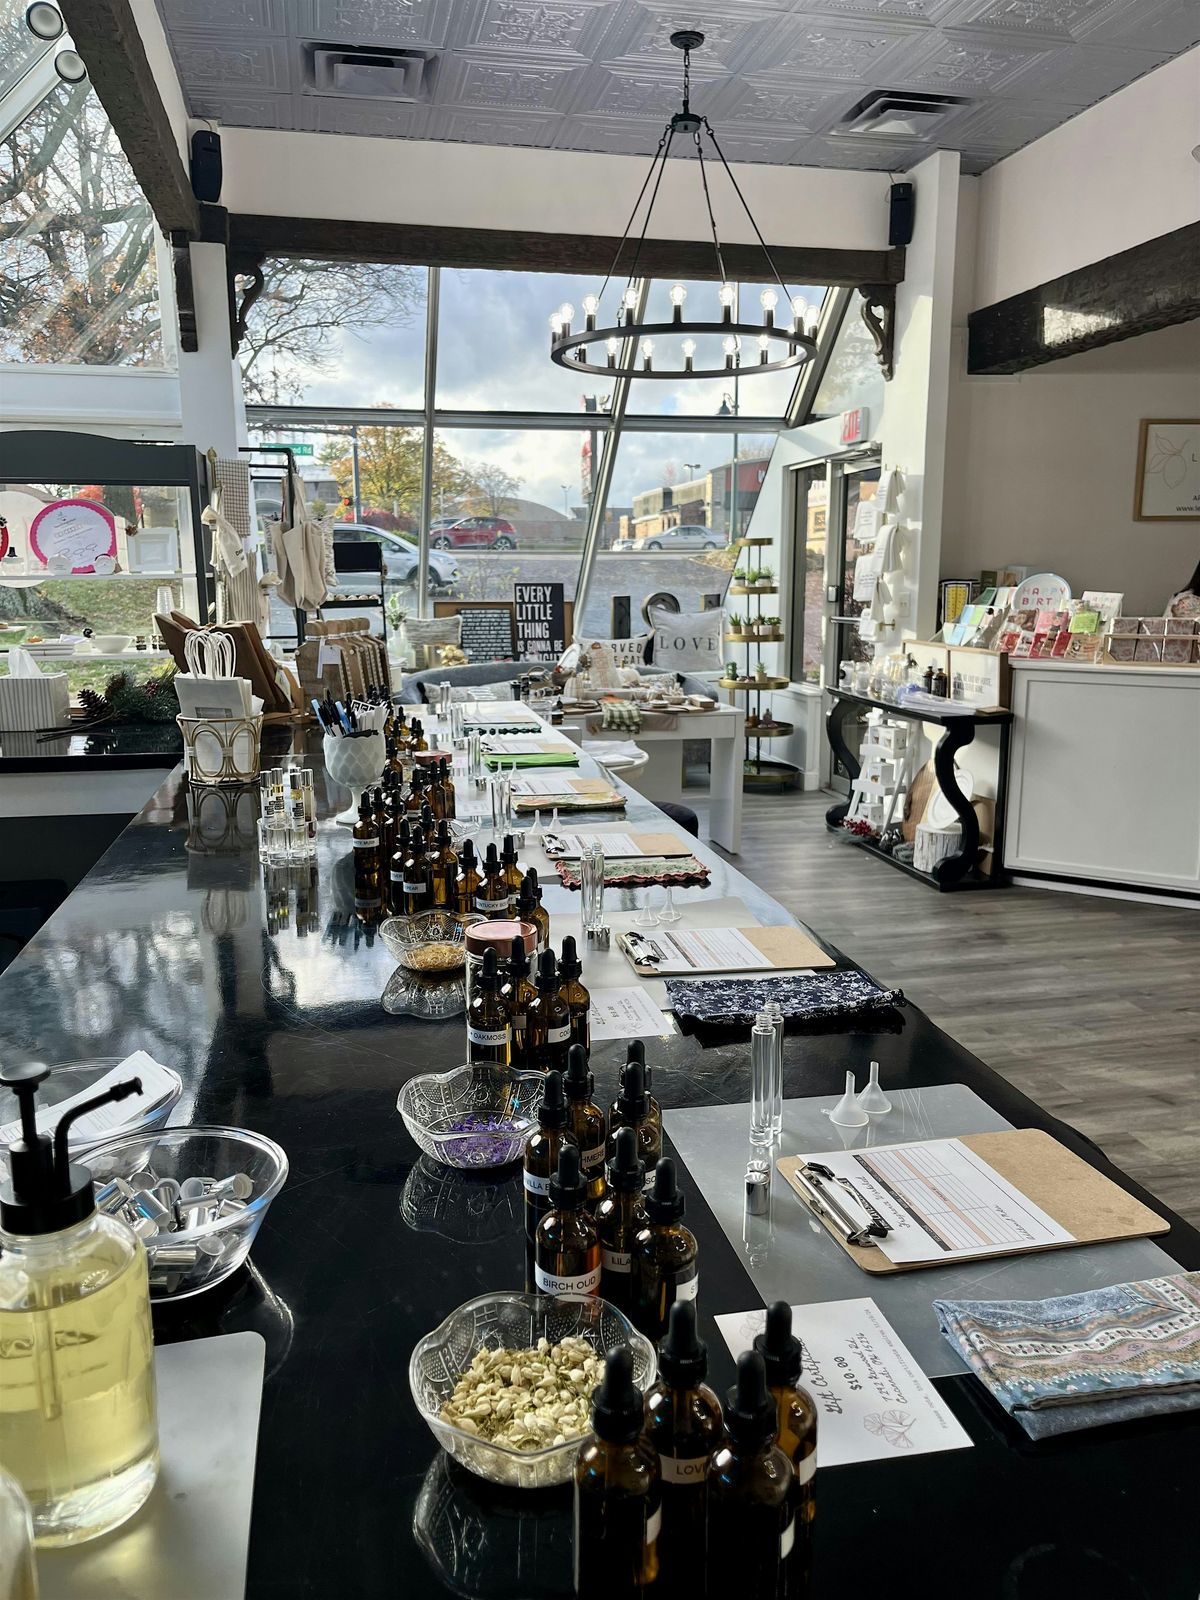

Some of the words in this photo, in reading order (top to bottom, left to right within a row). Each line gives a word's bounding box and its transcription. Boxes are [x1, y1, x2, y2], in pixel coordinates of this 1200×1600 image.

[515, 586, 552, 602] EVERY
[516, 604, 553, 620] LITTLE
[517, 622, 550, 638] THING
[517, 640, 525, 652] IS
[527, 640, 552, 652] GONNA
[553, 640, 564, 652] BE
[660, 636, 718, 651] LOVE
[473, 1032, 507, 1041] OAKMOSS
[611, 1257, 631, 1266] LILA
[543, 1277, 573, 1291] BIRCH
[576, 1275, 596, 1290] OUD
[798, 1337, 828, 1387] Certific
[834, 1356, 863, 1390] $10.00
[817, 1391, 843, 1414] Gift
